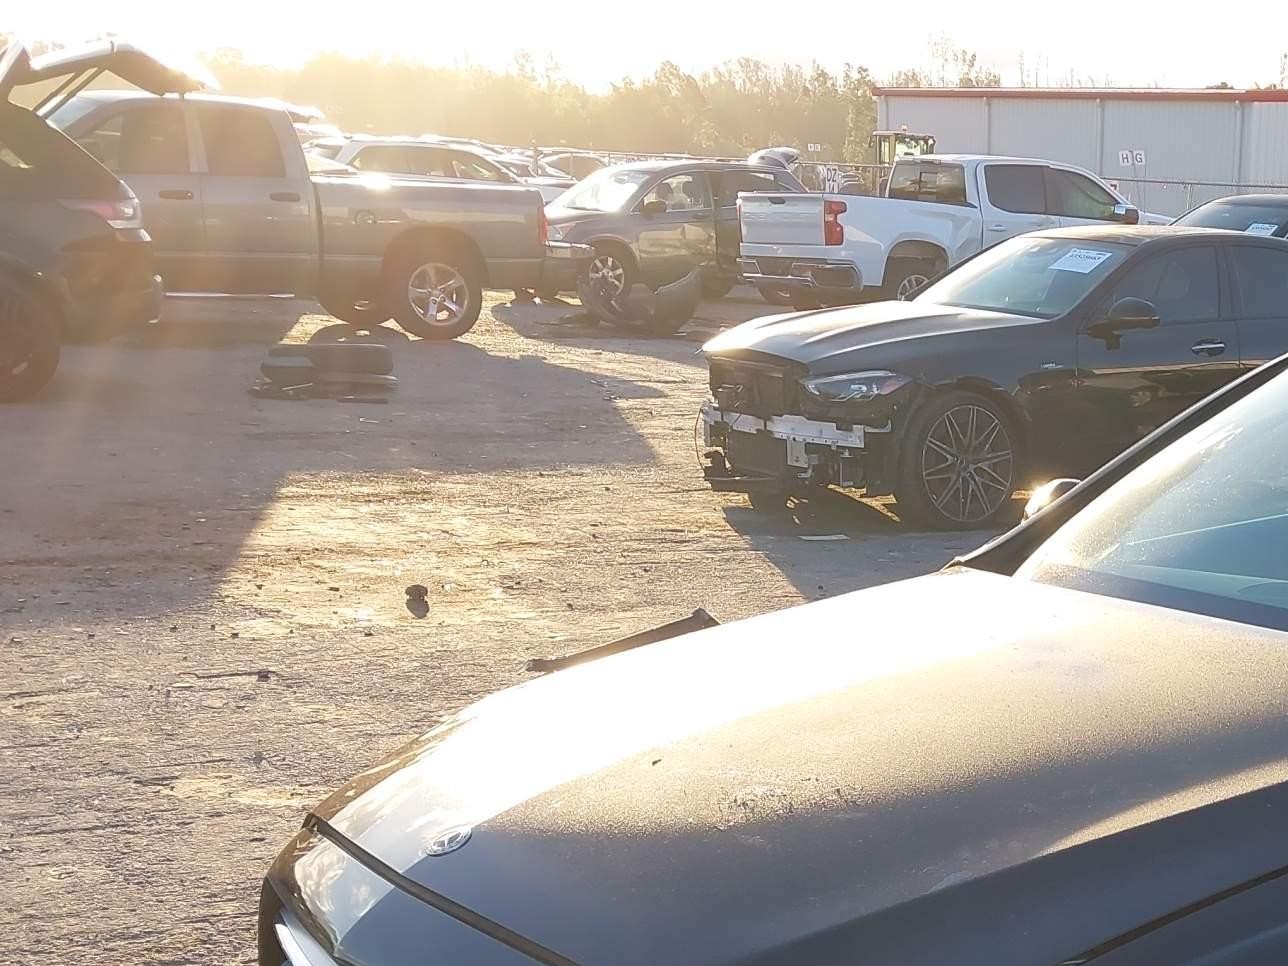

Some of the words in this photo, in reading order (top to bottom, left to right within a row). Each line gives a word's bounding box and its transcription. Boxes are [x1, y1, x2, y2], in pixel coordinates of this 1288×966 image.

[1121, 153, 1129, 164] H
[1135, 153, 1143, 163] G
[826, 168, 838, 182] DZ
